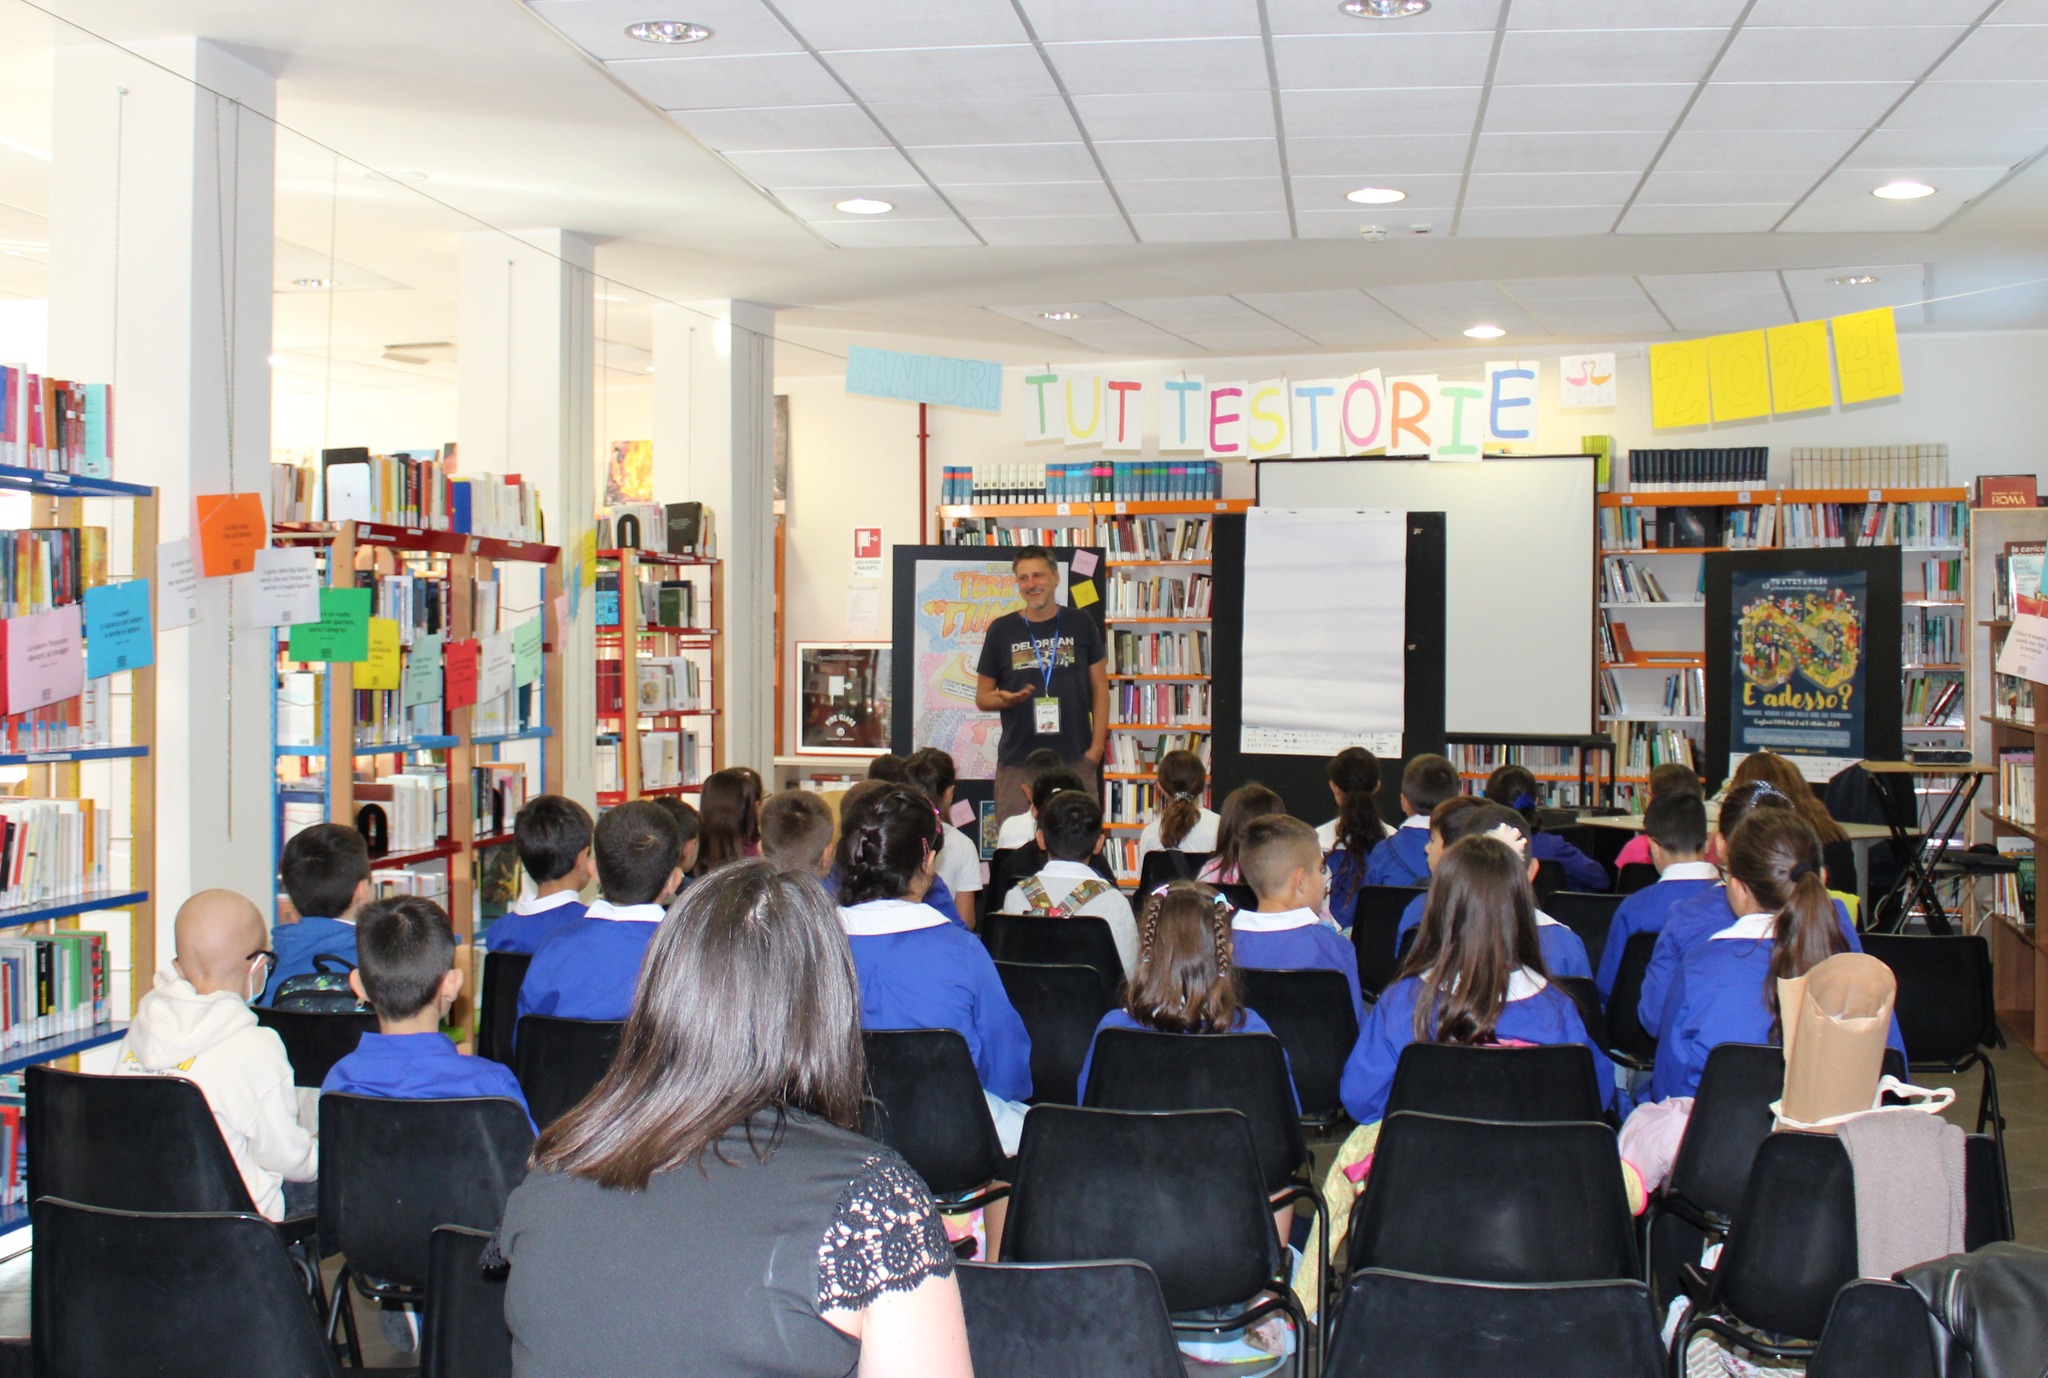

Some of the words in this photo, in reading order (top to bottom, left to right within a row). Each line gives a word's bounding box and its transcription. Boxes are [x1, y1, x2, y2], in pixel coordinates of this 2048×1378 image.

[848, 349, 1001, 409] SANLURI
[1657, 318, 1890, 428] 2024
[1991, 495, 2026, 505] ROMA
[1011, 636, 1075, 653] DELOREAN
[1743, 681, 1757, 706] E
[1763, 684, 1854, 711] adesso?
[825, 714, 838, 727] FIRE
[837, 713, 857, 727] GLASS
